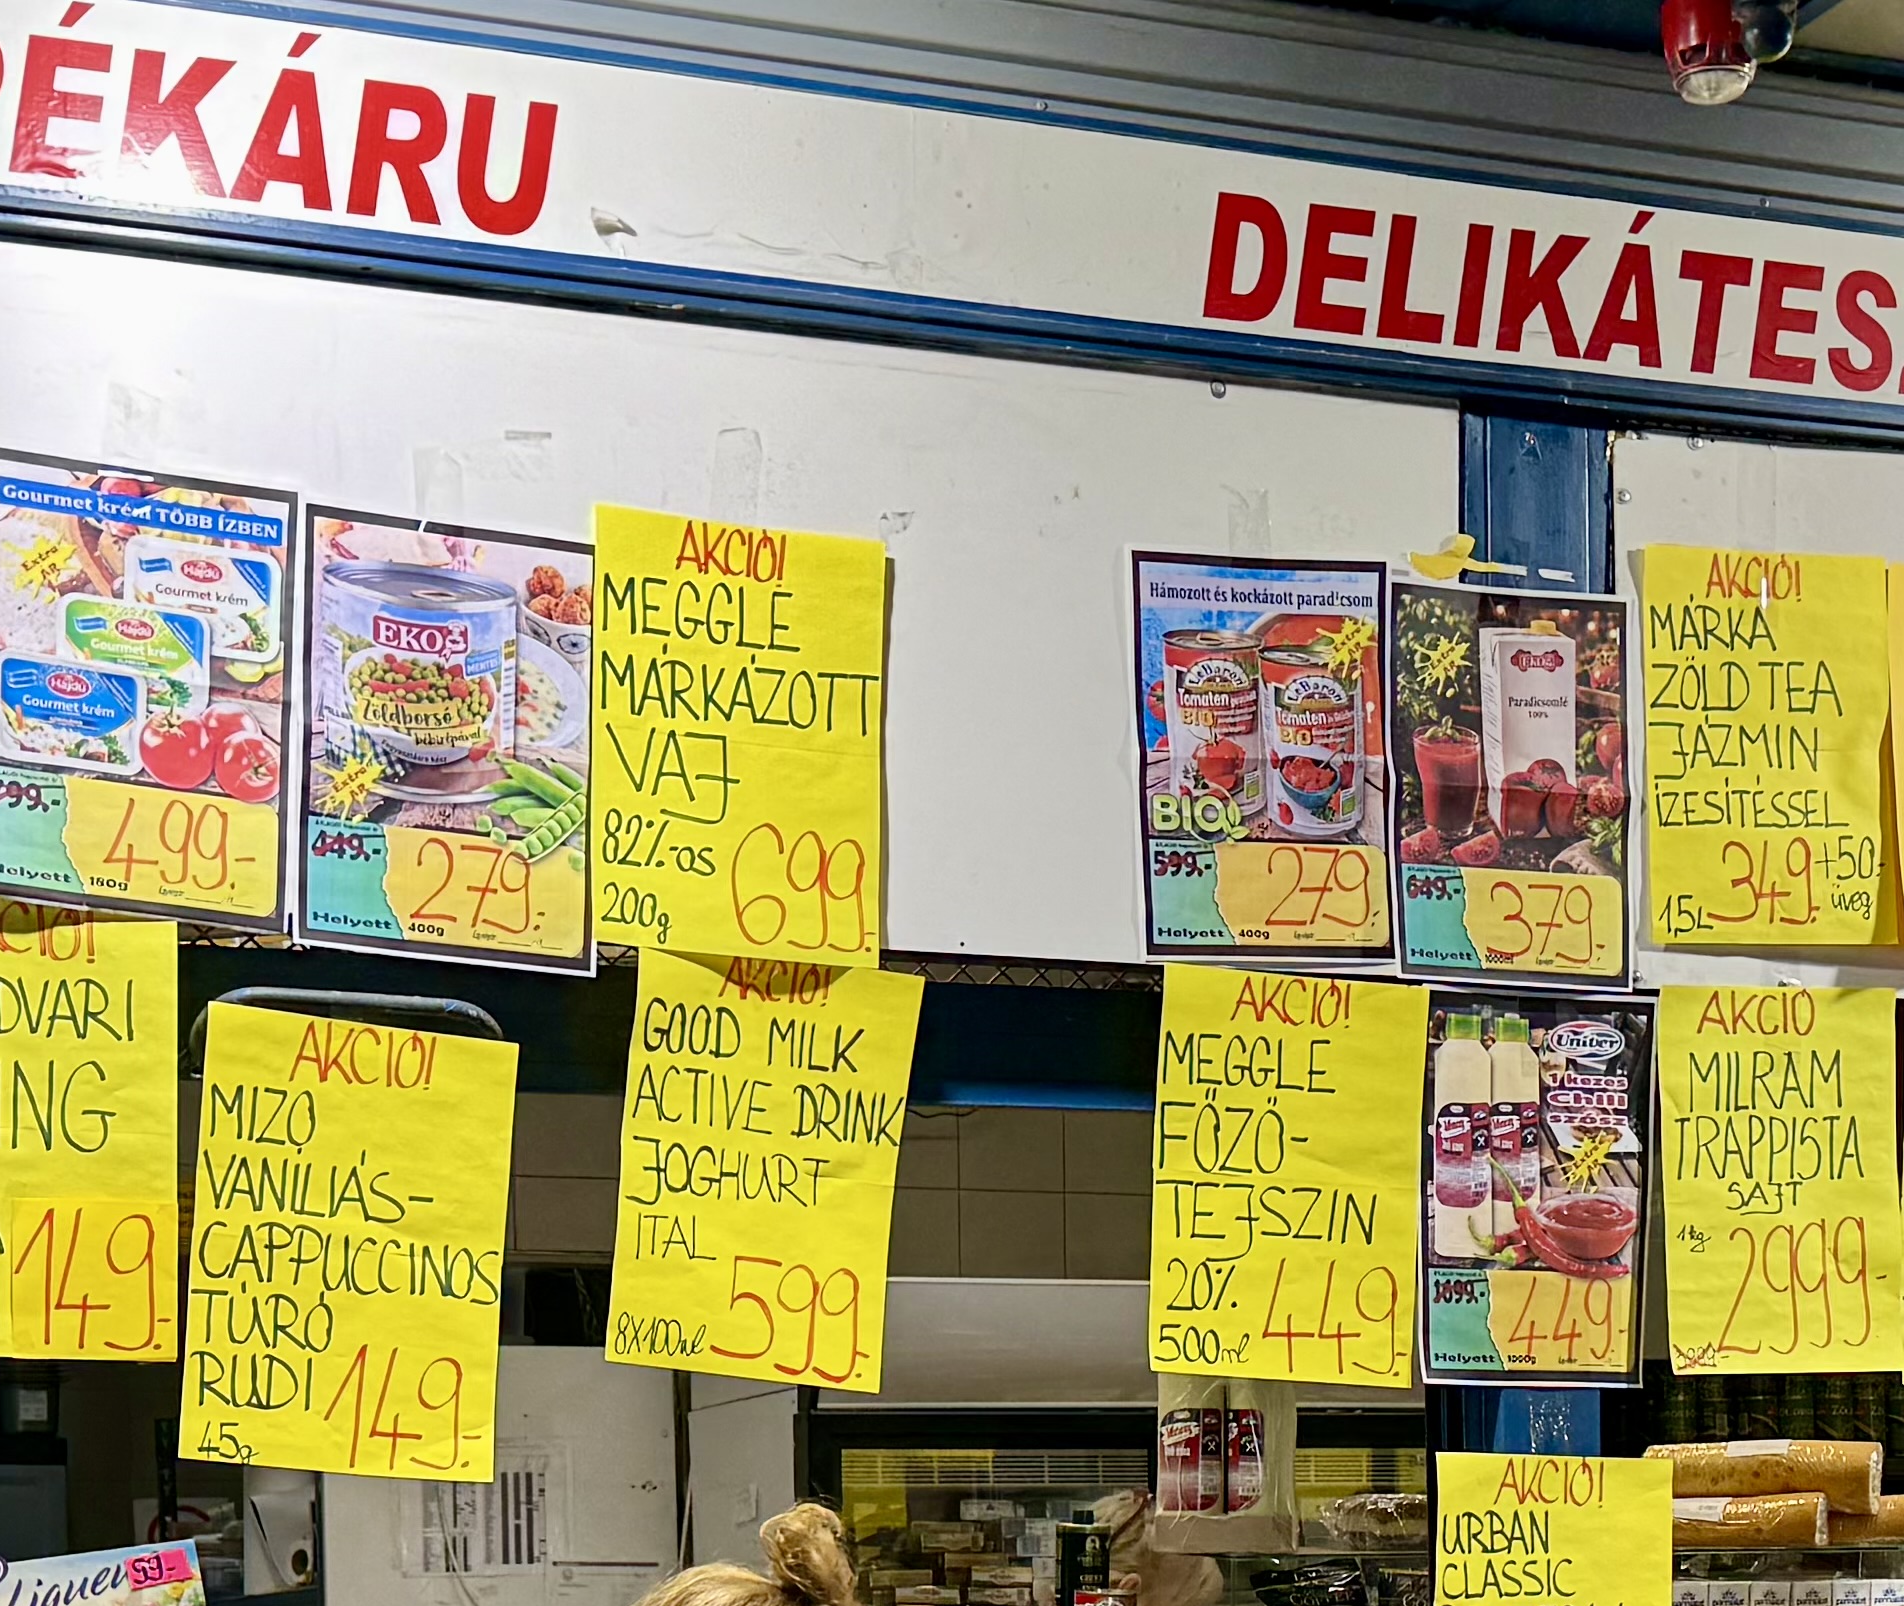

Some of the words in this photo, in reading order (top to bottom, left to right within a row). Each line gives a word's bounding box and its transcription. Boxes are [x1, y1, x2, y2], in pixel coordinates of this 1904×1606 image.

[2, 483, 93, 513] Gourmet
[96, 492, 152, 522] krém
[155, 507, 213, 531] TÖBB
[218, 513, 278, 539] ÍZBEN
[378, 624, 443, 653] EKO
[601, 572, 800, 652] MEGGLE
[1650, 594, 1777, 651] MÁRKA
[361, 698, 453, 725] Zöldborsó
[601, 642, 879, 736] MÁRKÁZOTT
[1508, 696, 1568, 709] Paradicsomlé
[1650, 656, 1750, 712] ZÖLD
[1758, 660, 1843, 717] TEA
[605, 722, 740, 824] VAJ
[1649, 715, 1818, 780] JÁZMIN
[1152, 794, 1229, 832] BIO
[643, 997, 741, 1059] GOOD
[768, 1017, 865, 1073] MILK
[1163, 1031, 1336, 1094] MEGGLE
[1556, 1034, 1620, 1051] Univer
[632, 1064, 773, 1135] ACTIVE
[790, 1083, 905, 1147] DRINK
[1689, 1049, 1842, 1112] MILRAM
[209, 1083, 317, 1147] MIZO
[626, 1135, 830, 1207] JOGHURT
[1674, 1115, 1864, 1180] TRAPPISTA
[198, 1221, 499, 1305] CAPPUCCINOS
[191, 1284, 333, 1353] TÚRÓ
[190, 1351, 313, 1412] RUDI
[1494, 1457, 1605, 1509] AKCIÓ!
[1442, 1510, 1549, 1555] URBAN
[1441, 1558, 1577, 1599] CLASSIC
